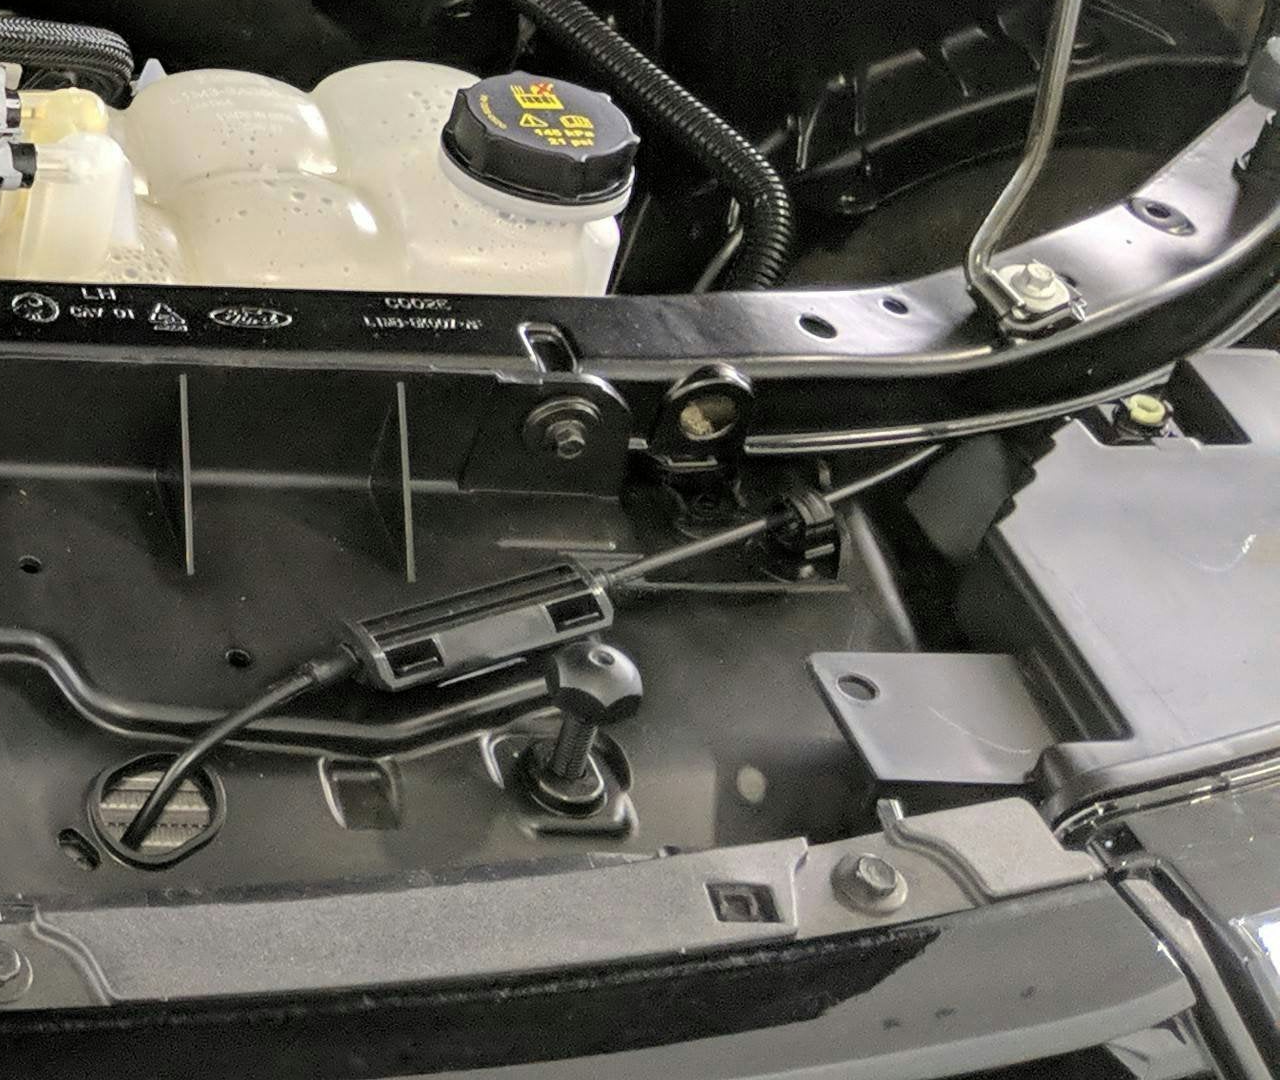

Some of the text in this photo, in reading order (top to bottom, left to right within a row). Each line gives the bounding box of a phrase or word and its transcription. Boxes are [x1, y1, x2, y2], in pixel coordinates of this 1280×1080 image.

[564, 129, 595, 138] kPa
[548, 138, 594, 148] 21 psi
[80, 287, 117, 301] LH
